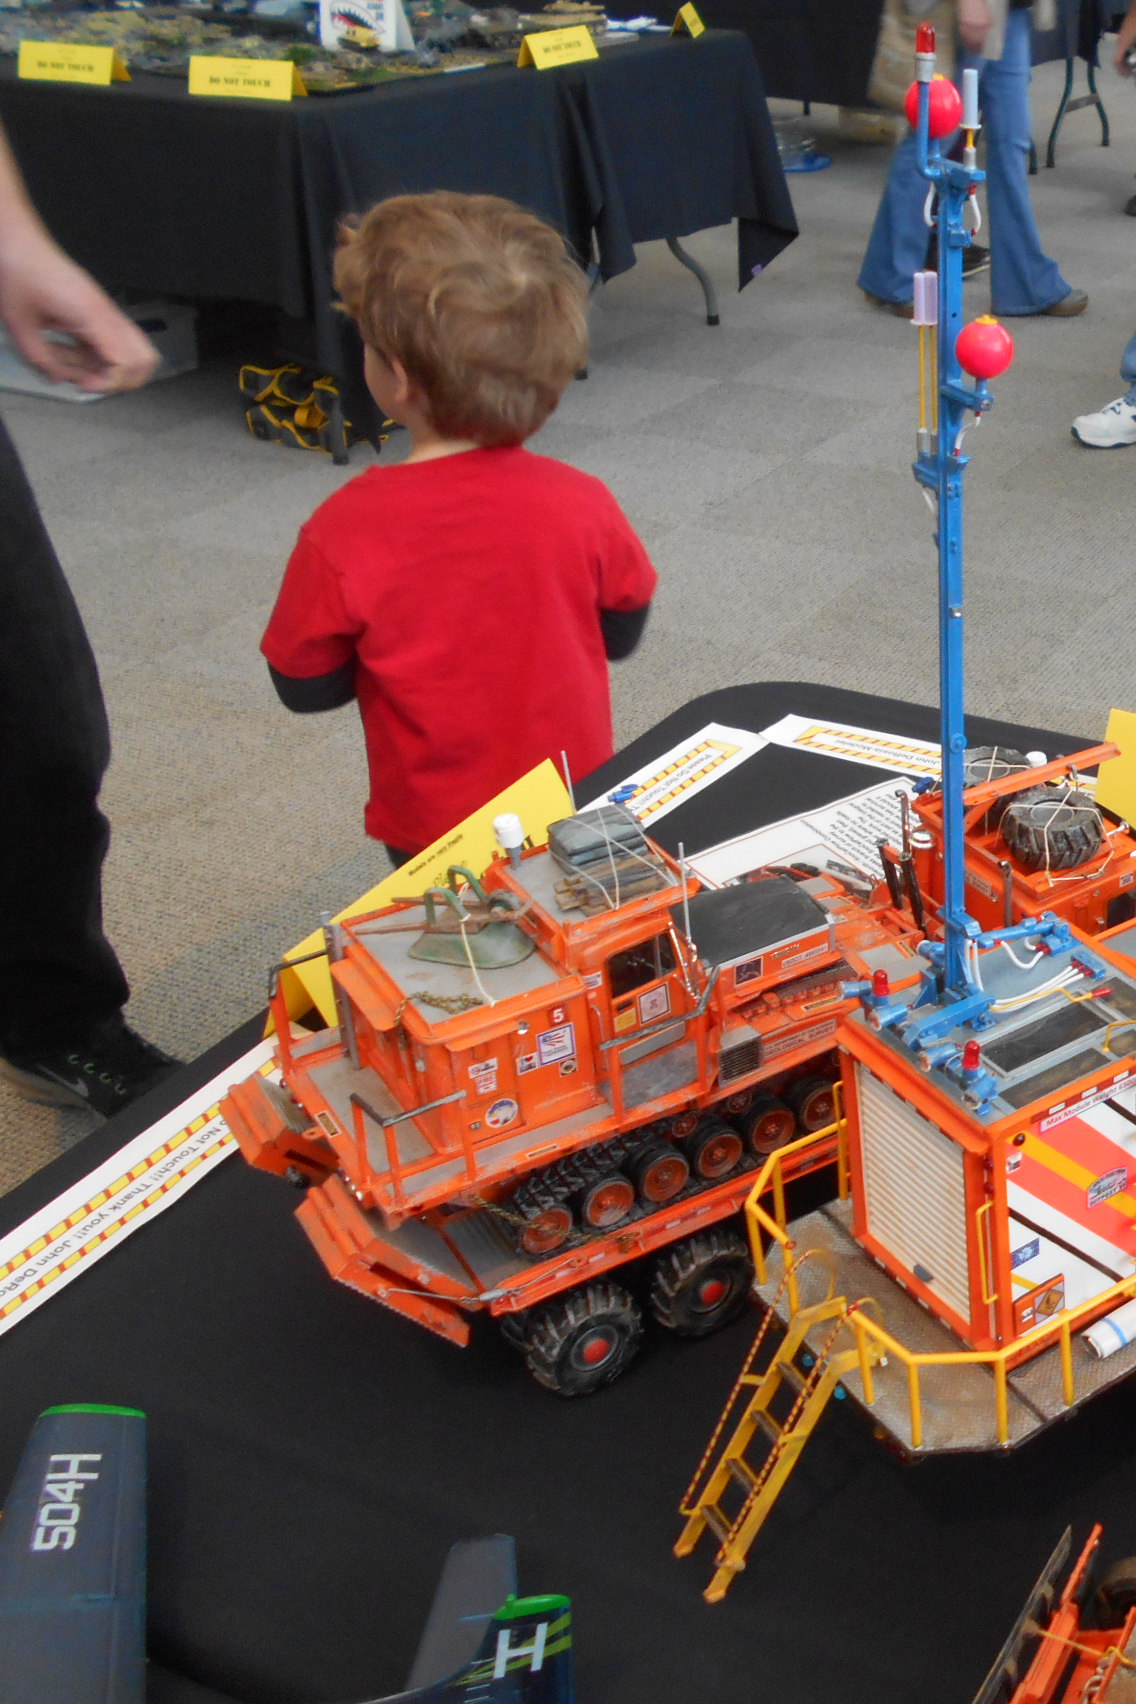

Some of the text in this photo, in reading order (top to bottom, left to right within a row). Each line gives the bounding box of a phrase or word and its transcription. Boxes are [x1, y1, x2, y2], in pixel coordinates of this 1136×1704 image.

[915, 755, 939, 766] John
[552, 1008, 564, 1023] 5
[1045, 1113, 1063, 1126] Max
[1062, 1098, 1092, 1117] Module
[1093, 1086, 1118, 1103] Weight
[195, 1125, 219, 1146] Not
[148, 1142, 198, 1184] Touch!!
[103, 1177, 152, 1218] Thank
[72, 1210, 107, 1240] you!!
[35, 1237, 73, 1269] John
[30, 1453, 102, 1552] 504H
[493, 1622, 548, 1679] H
